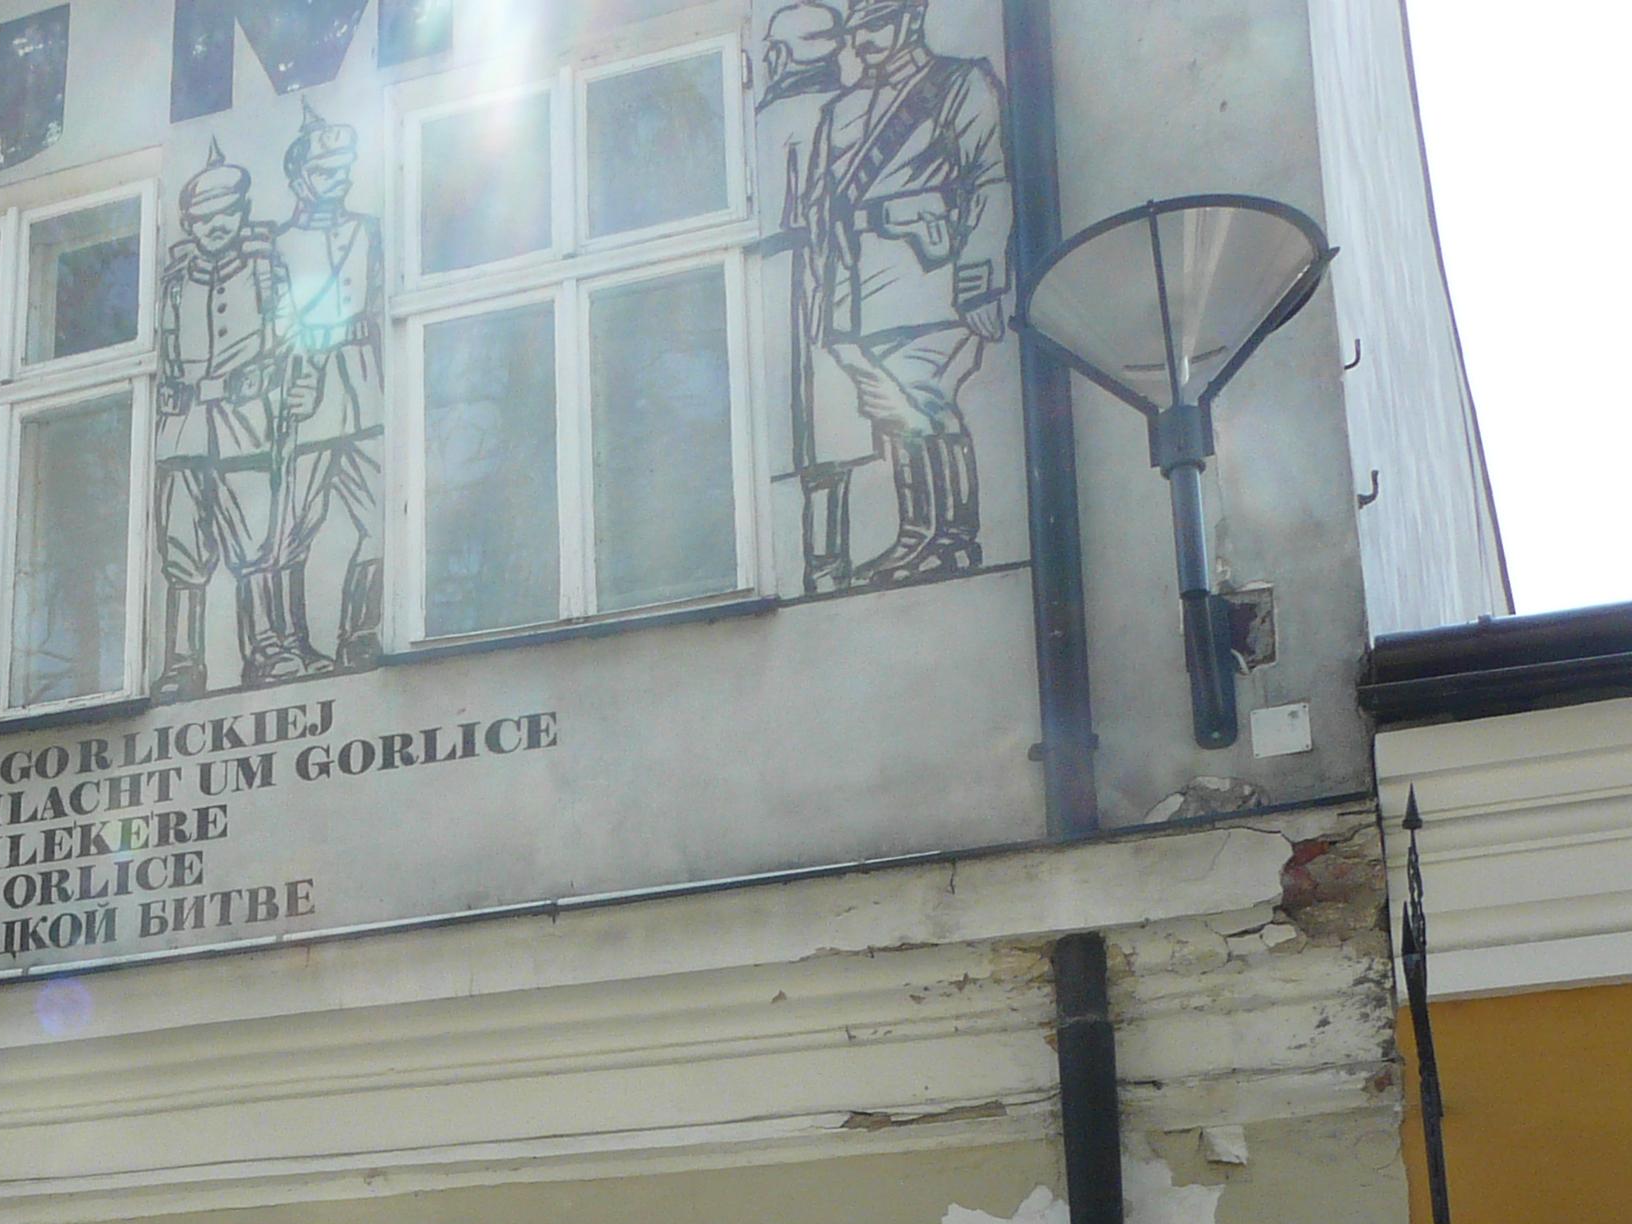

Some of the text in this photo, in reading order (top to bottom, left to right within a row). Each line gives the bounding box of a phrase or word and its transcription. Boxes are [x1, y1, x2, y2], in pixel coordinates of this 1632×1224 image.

[0, 700, 336, 786] GORLICKIEJ
[198, 751, 277, 796] UM
[294, 711, 559, 781] GORLICE
[138, 877, 316, 938] БИТВЕ
